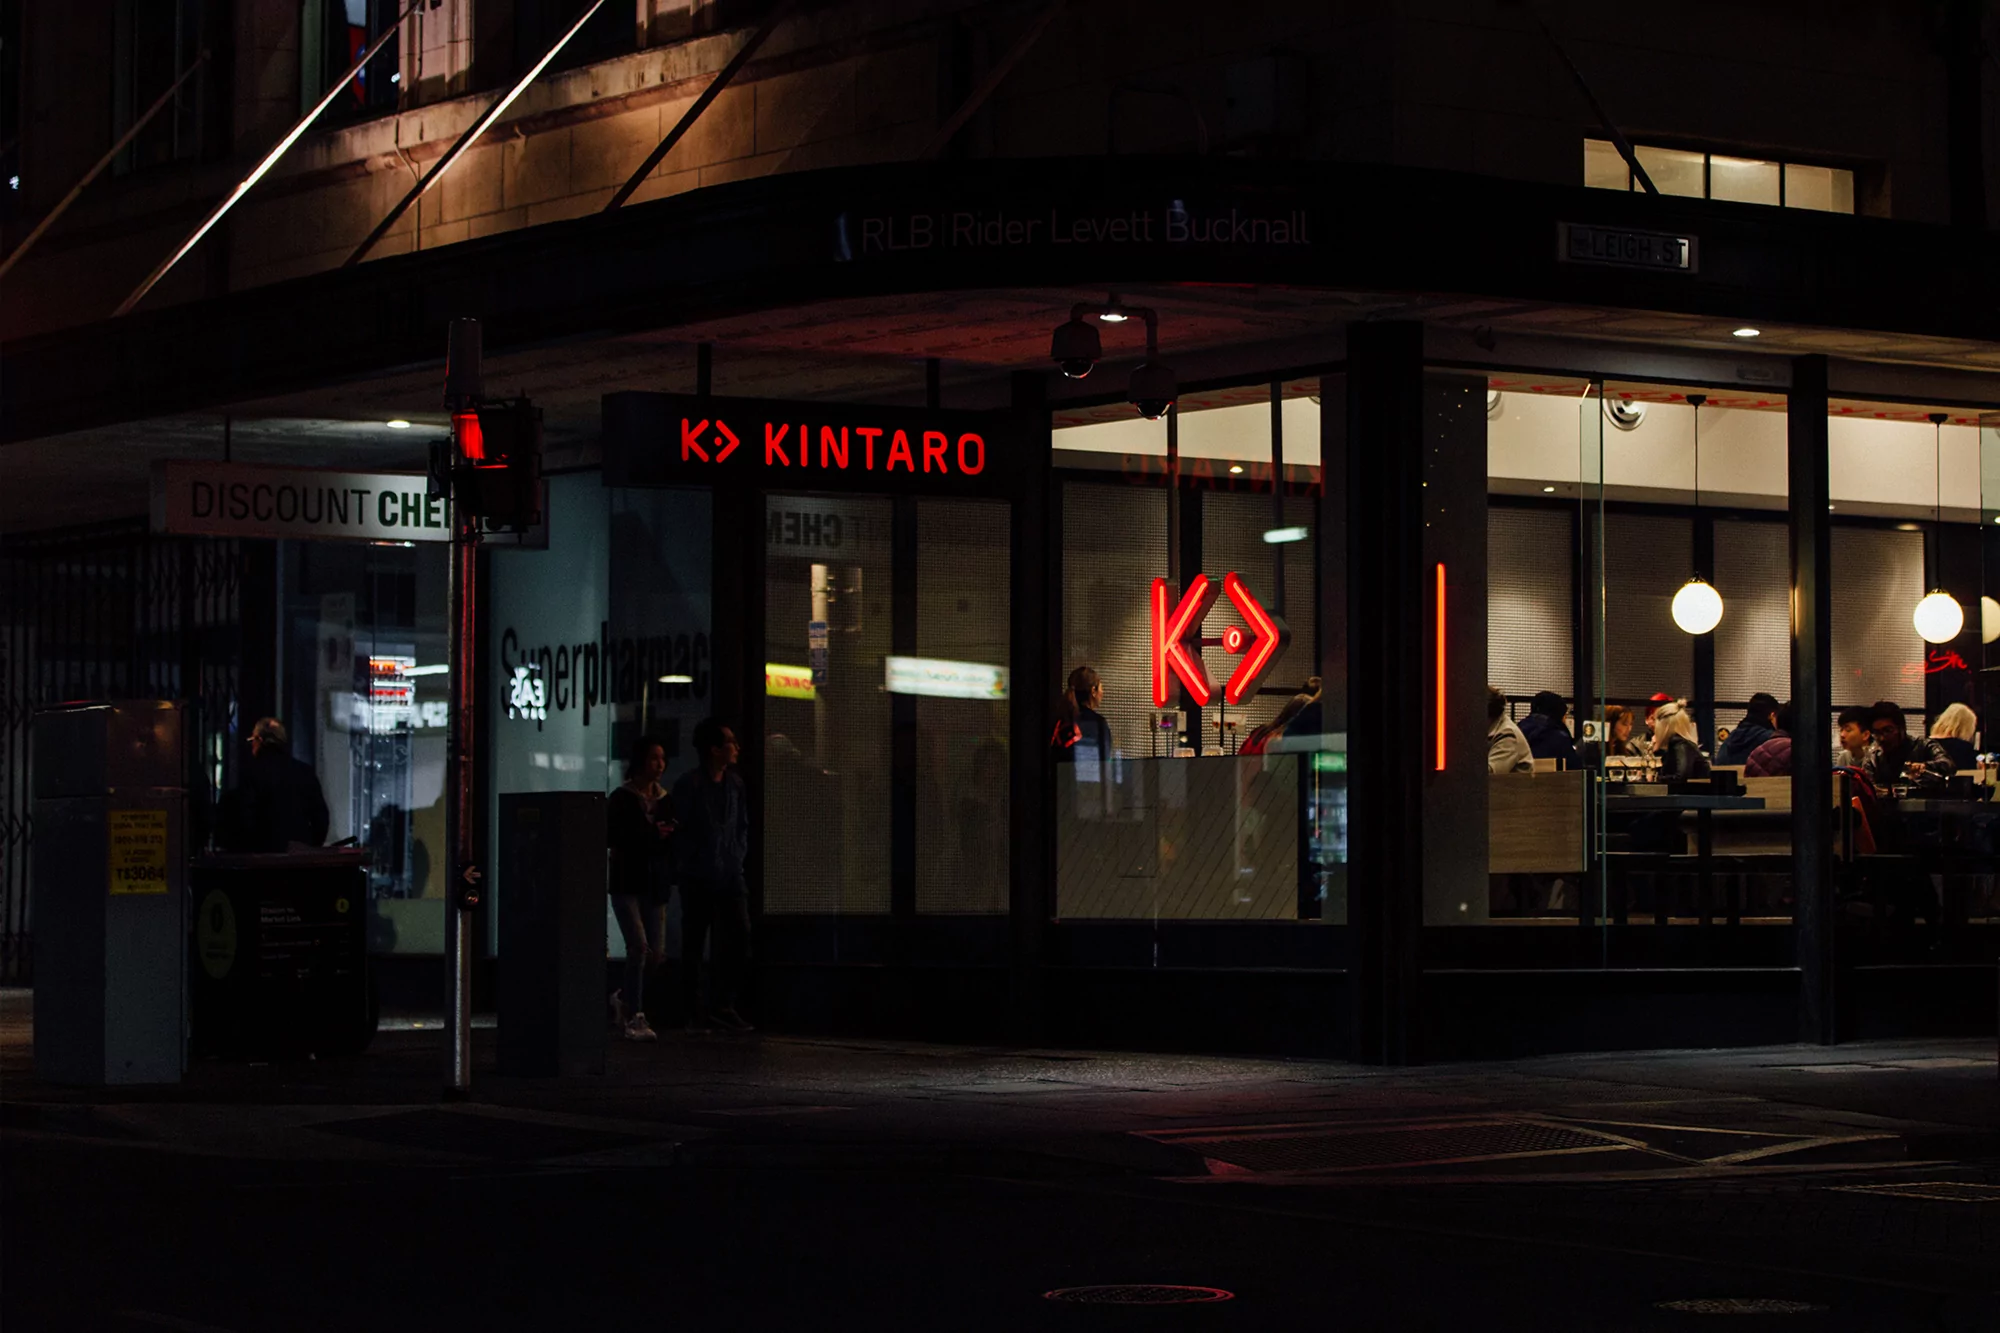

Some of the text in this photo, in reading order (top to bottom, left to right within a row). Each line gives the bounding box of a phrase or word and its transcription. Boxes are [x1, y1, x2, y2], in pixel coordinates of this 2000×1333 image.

[861, 207, 1312, 253] RLB Rider Levett Bucknall
[1592, 233, 1687, 265] LEIGH ST
[764, 421, 986, 476] KINTARO
[191, 481, 450, 529] DISCOUNT CHE
